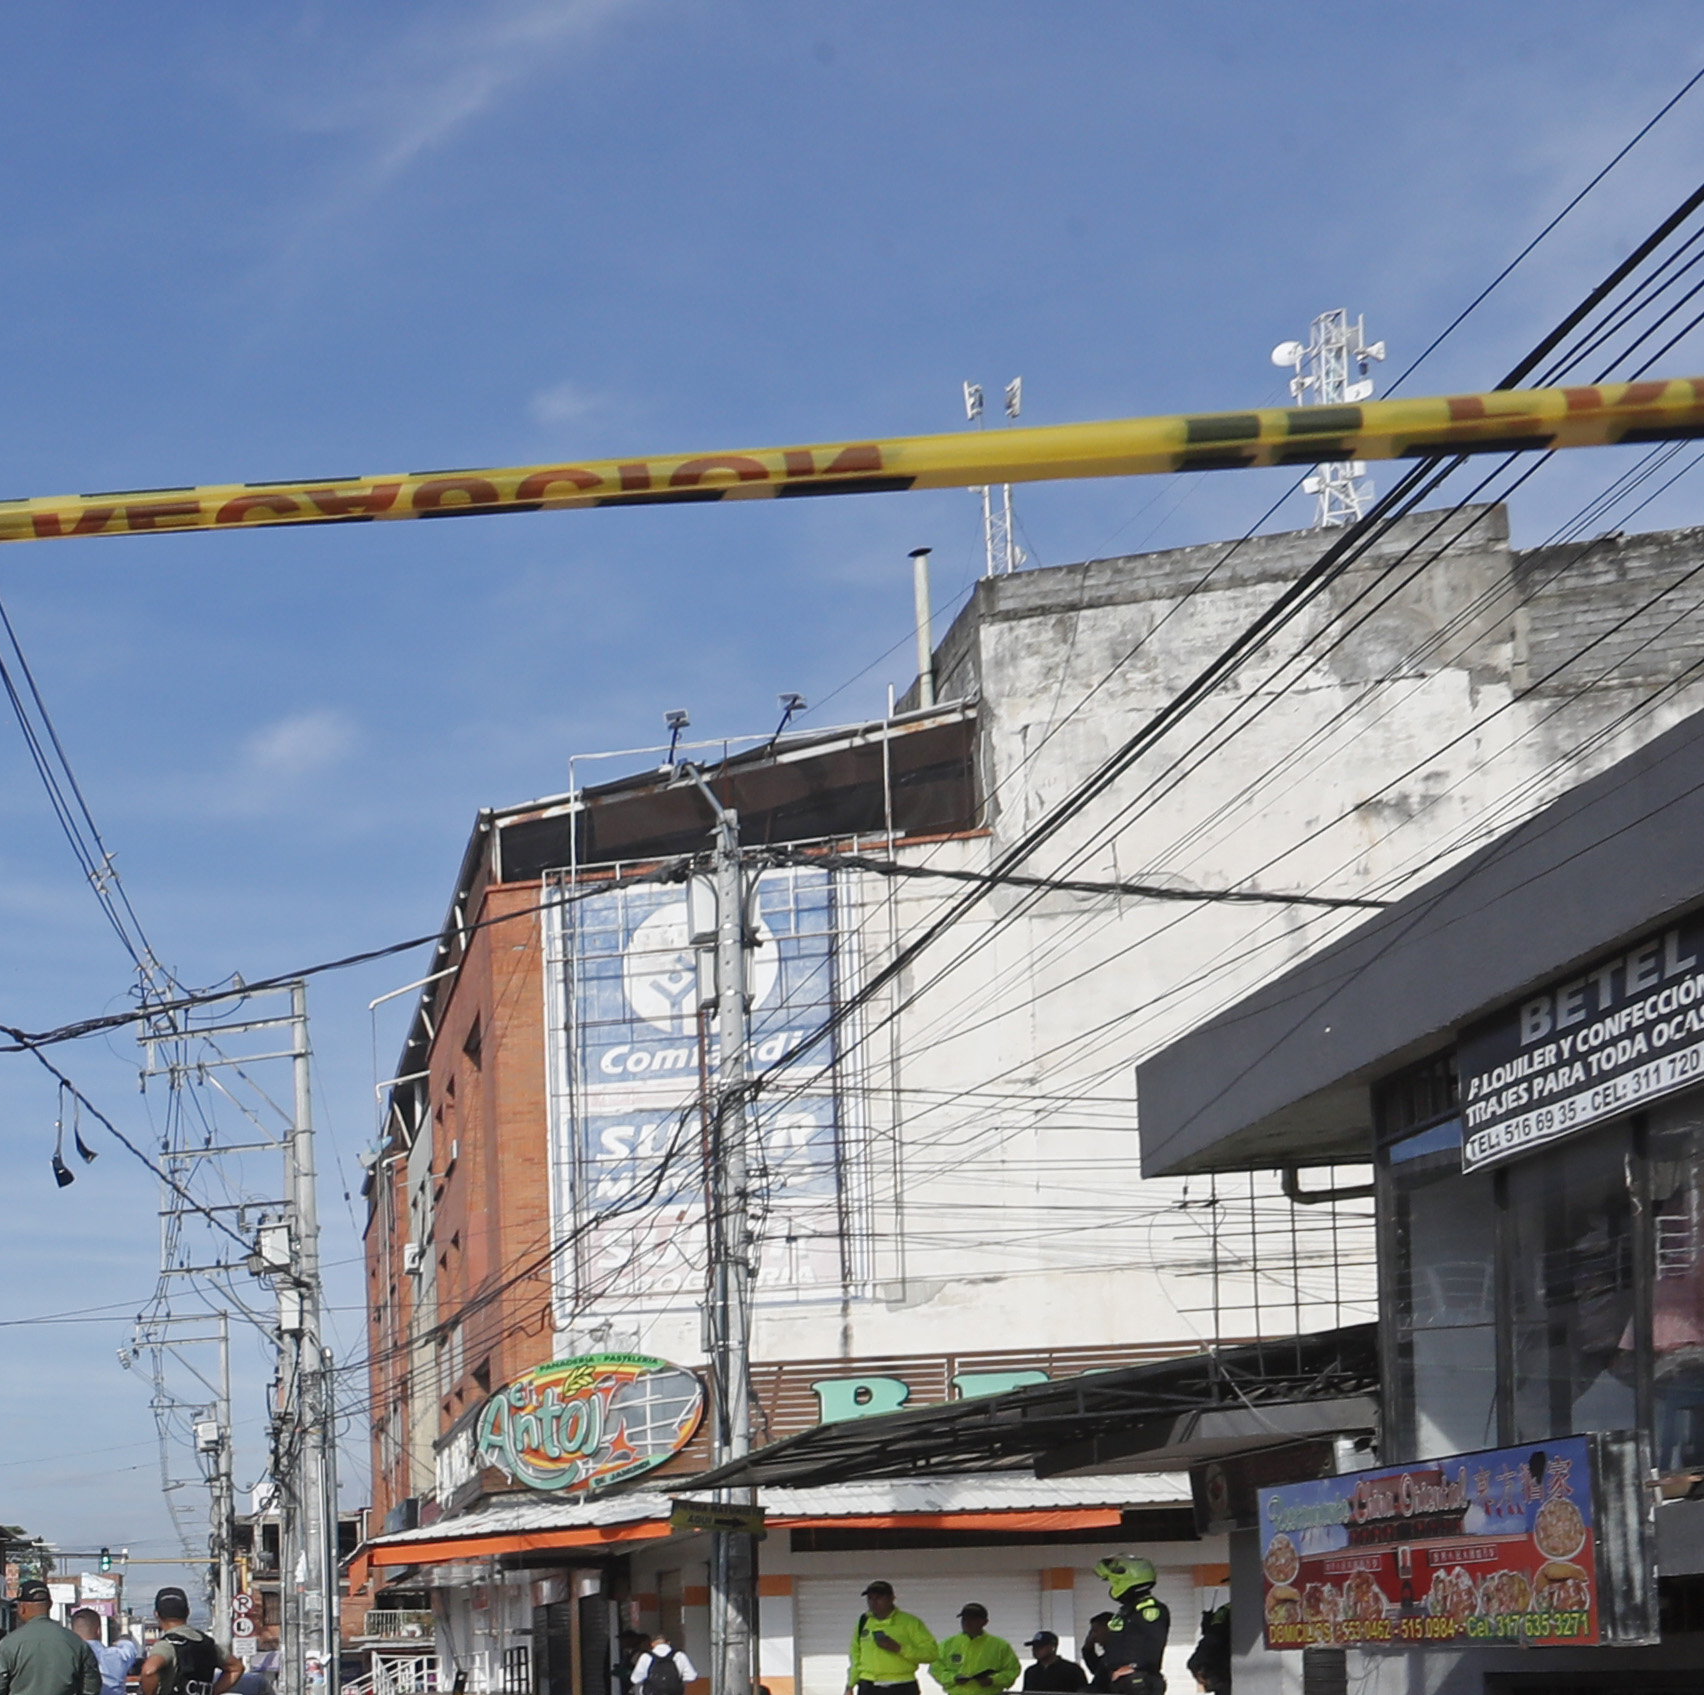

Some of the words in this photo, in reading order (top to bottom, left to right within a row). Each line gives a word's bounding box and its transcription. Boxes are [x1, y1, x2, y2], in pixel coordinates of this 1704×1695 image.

[1521, 928, 1697, 1047] BETEL
[1466, 1082, 1529, 1127] TRAJES
[1533, 1065, 1586, 1100] PARA
[1588, 1032, 1647, 1076] TODA
[1558, 1034, 1574, 1060] Y
[1469, 1132, 1502, 1159] TEL:
[1504, 1116, 1532, 1143] 516
[1536, 1109, 1554, 1130] 69
[1559, 1103, 1577, 1125] 35
[1592, 1086, 1629, 1113] CEL:
[1632, 1067, 1662, 1096] 311
[1668, 1049, 1700, 1080] 720
[1402, 1618, 1422, 1639] 515
[1496, 1615, 1520, 1637] 317
[1525, 1614, 1550, 1637] 635
[1554, 1612, 1590, 1636] 3271
